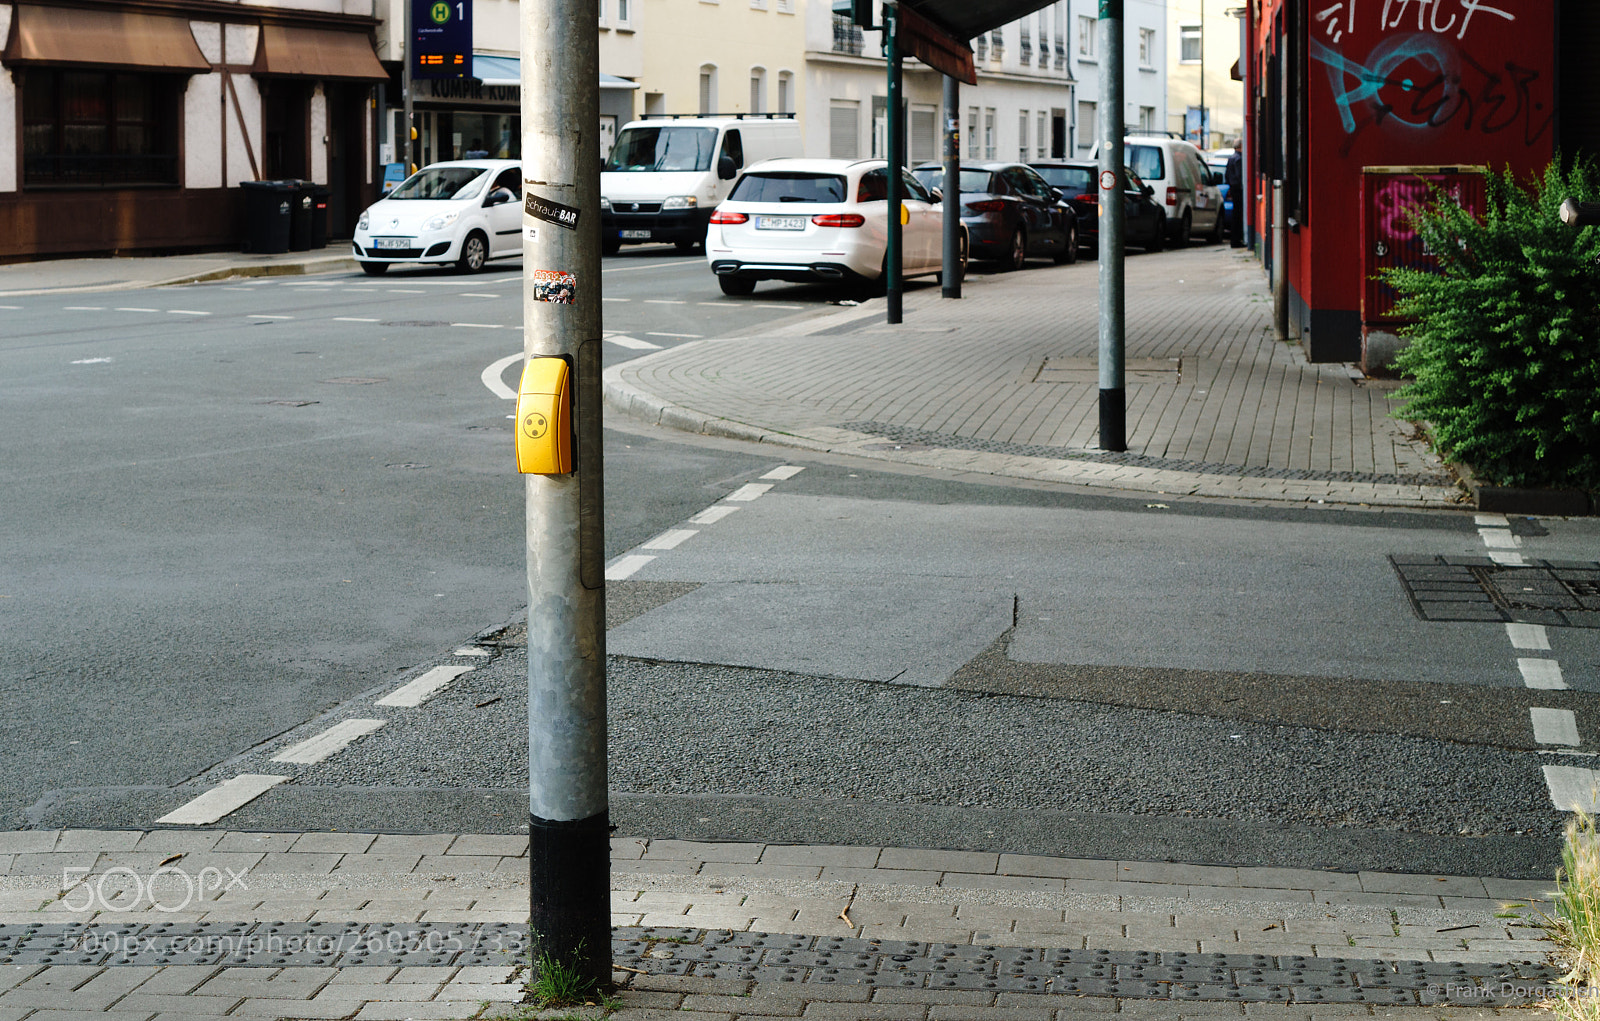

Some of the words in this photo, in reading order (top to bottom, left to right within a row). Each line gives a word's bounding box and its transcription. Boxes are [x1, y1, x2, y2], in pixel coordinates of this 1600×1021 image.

[456, 2, 464, 21] 1
[431, 78, 483, 99] KUMPIR
[489, 86, 520, 101] KUM
